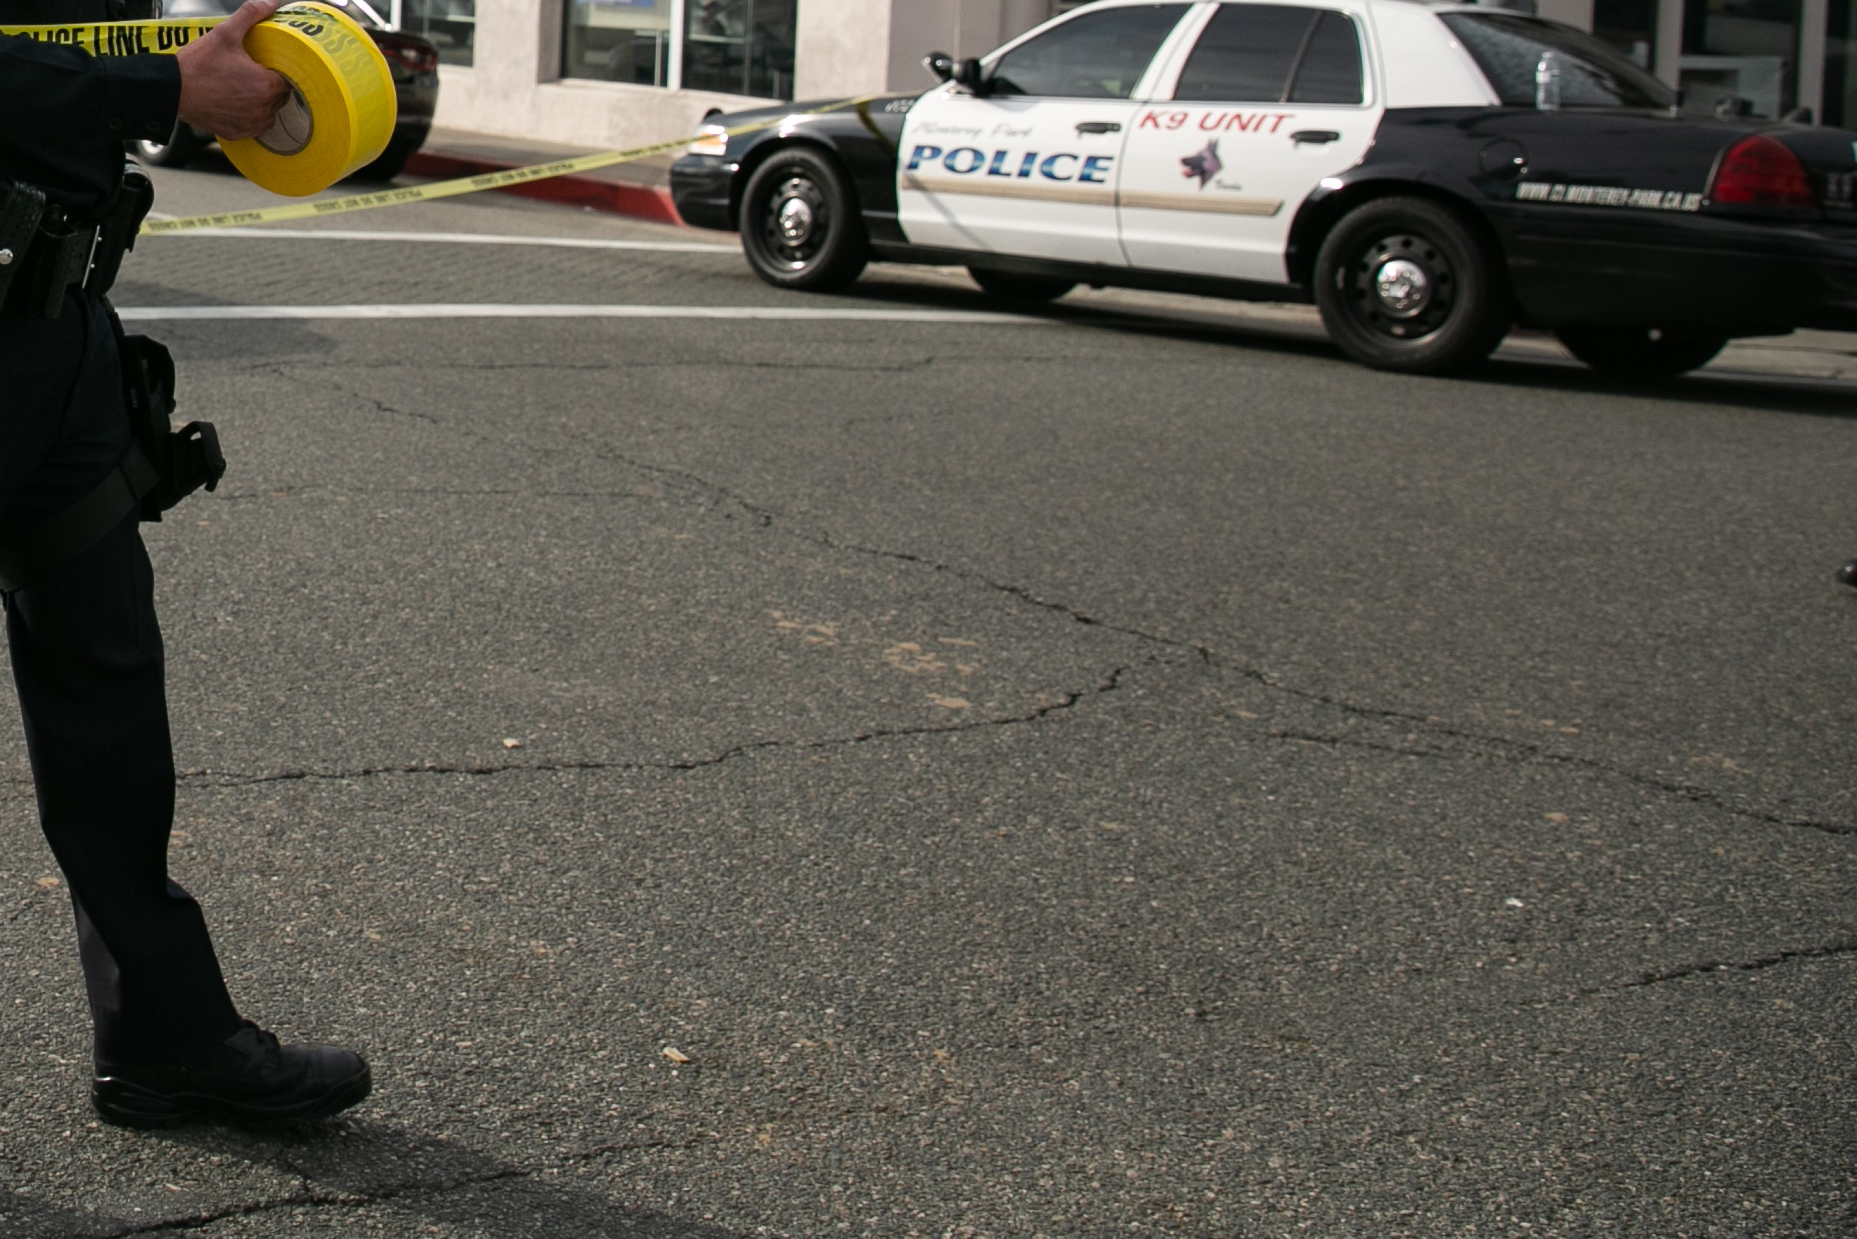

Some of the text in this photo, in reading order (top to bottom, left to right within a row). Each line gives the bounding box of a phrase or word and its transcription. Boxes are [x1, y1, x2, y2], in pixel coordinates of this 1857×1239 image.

[1139, 111, 1295, 134] K9 UNIT
[906, 144, 1115, 184] POLICE
